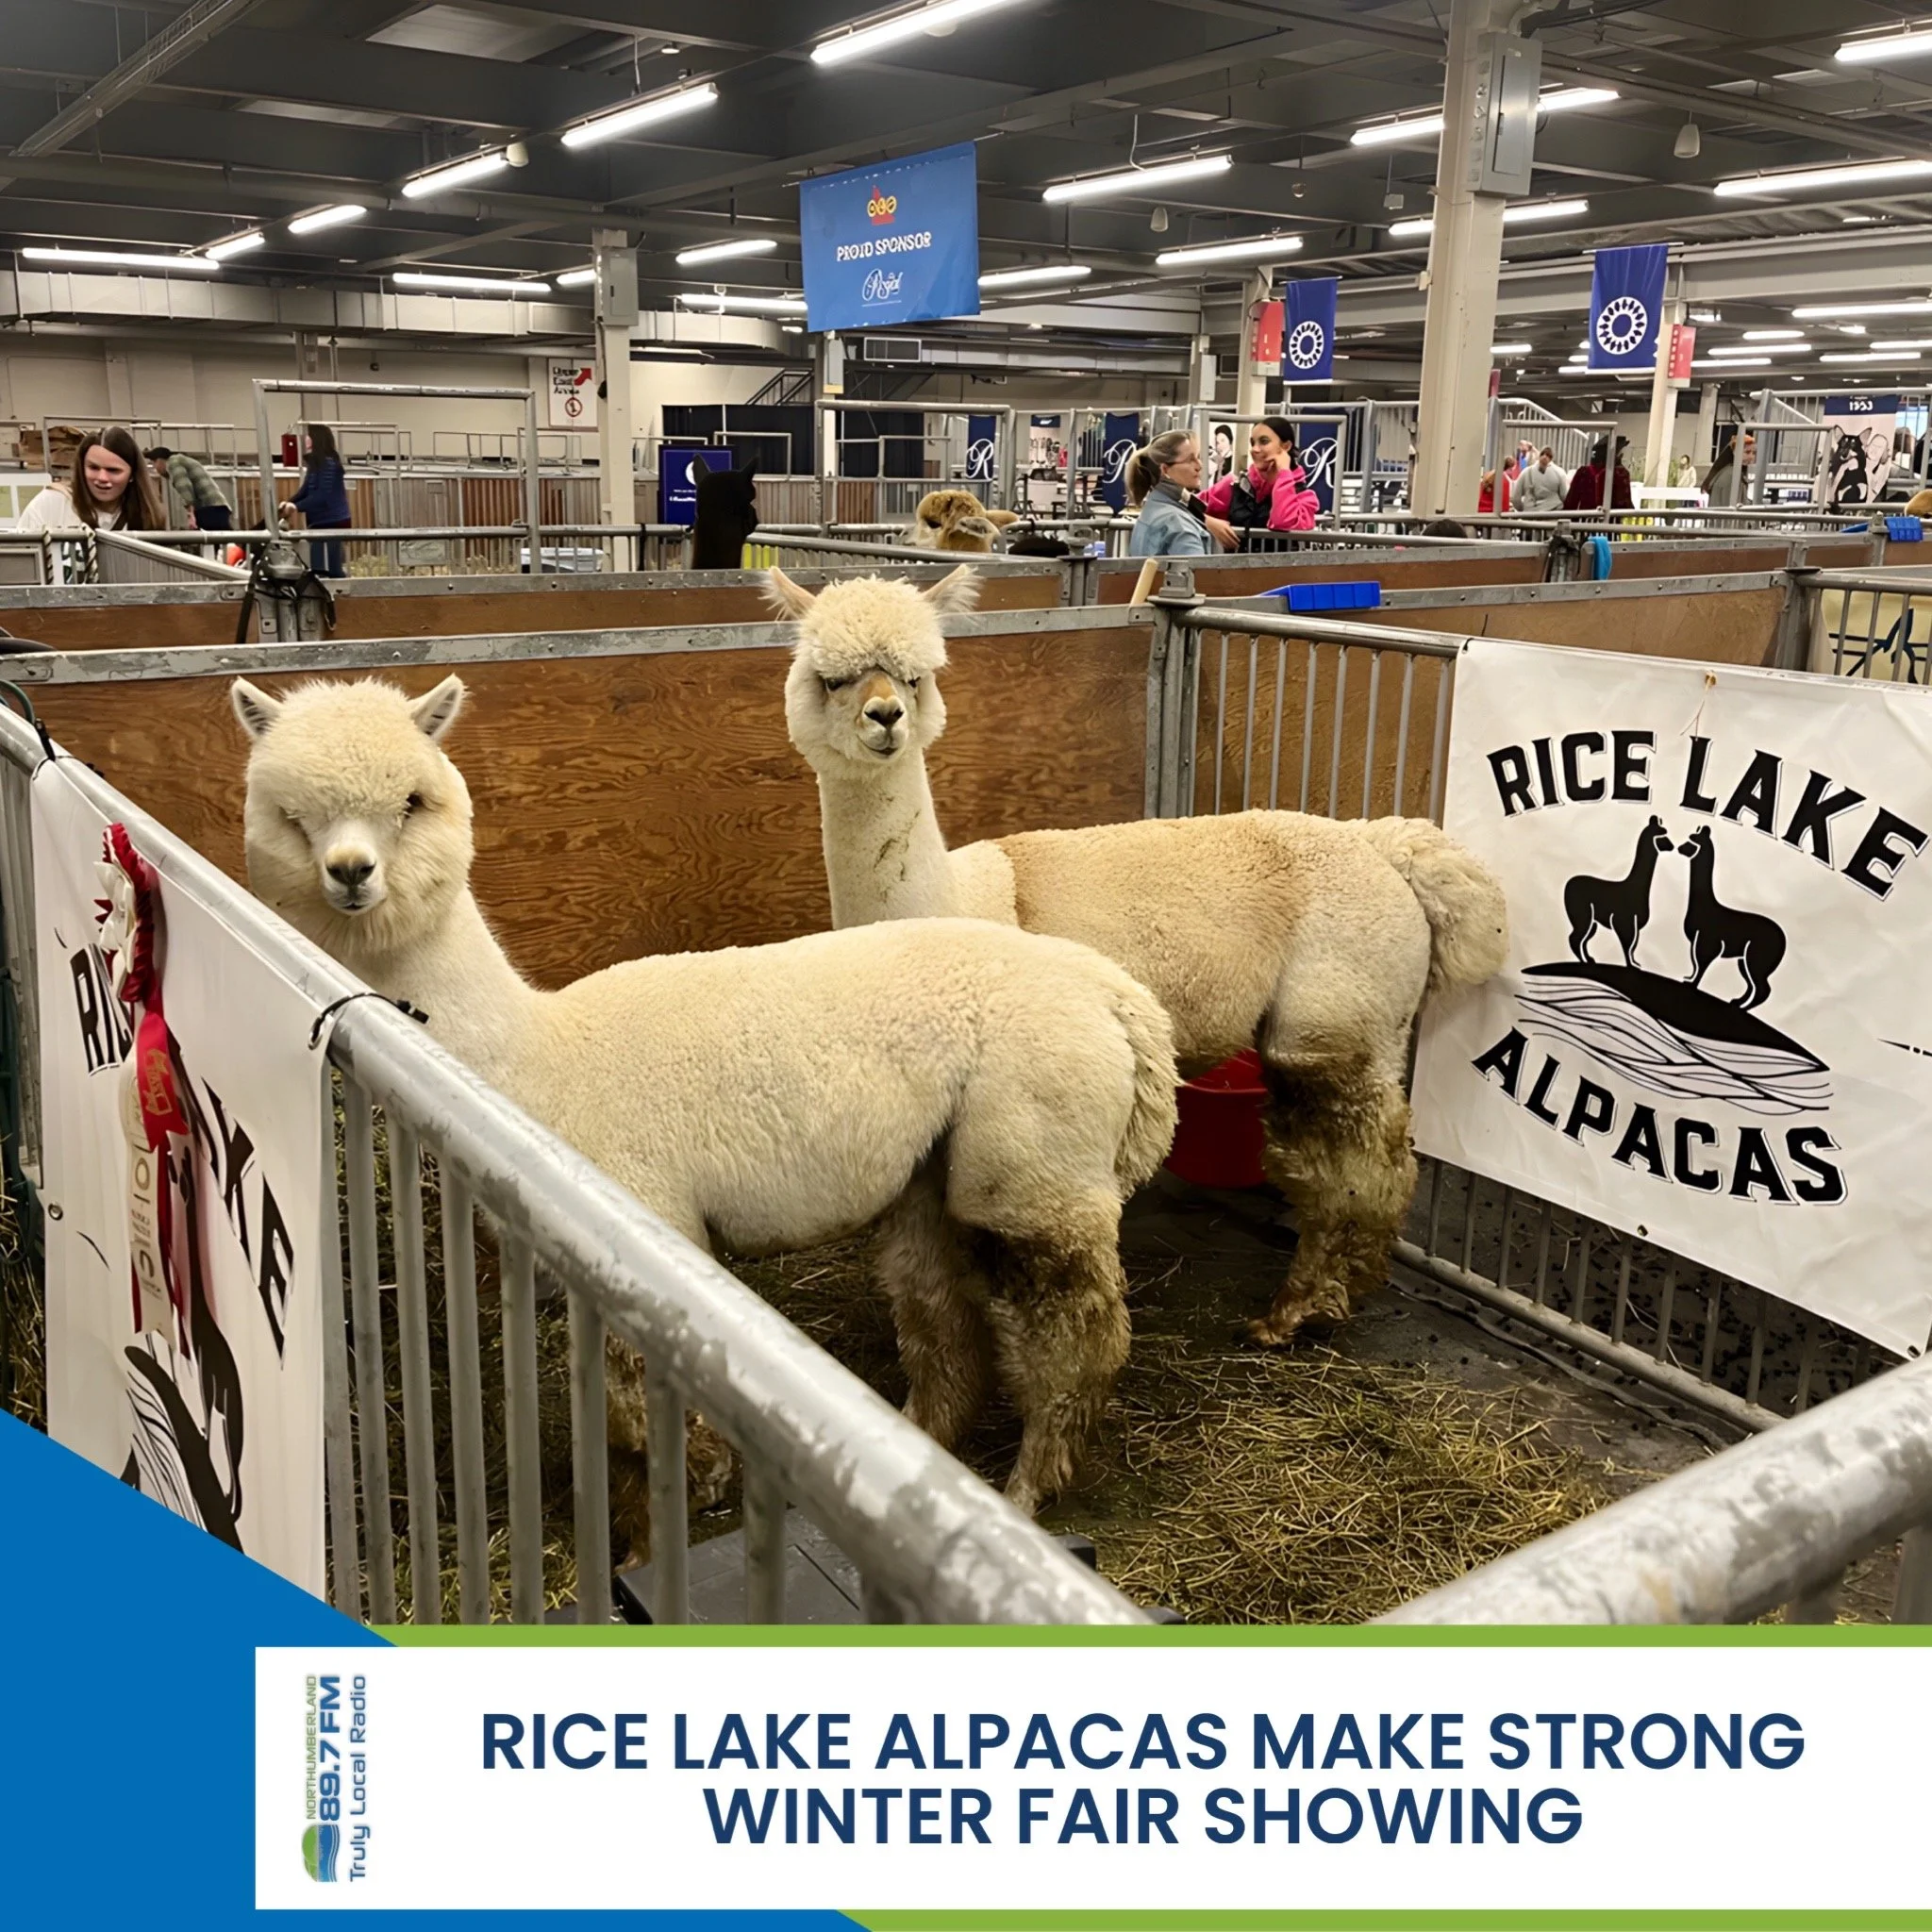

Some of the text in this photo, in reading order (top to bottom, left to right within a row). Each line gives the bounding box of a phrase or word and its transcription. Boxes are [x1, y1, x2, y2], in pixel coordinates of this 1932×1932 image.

[1487, 730, 1930, 902] RICE LAKE
[1470, 1025, 1849, 1207] ALPACAS
